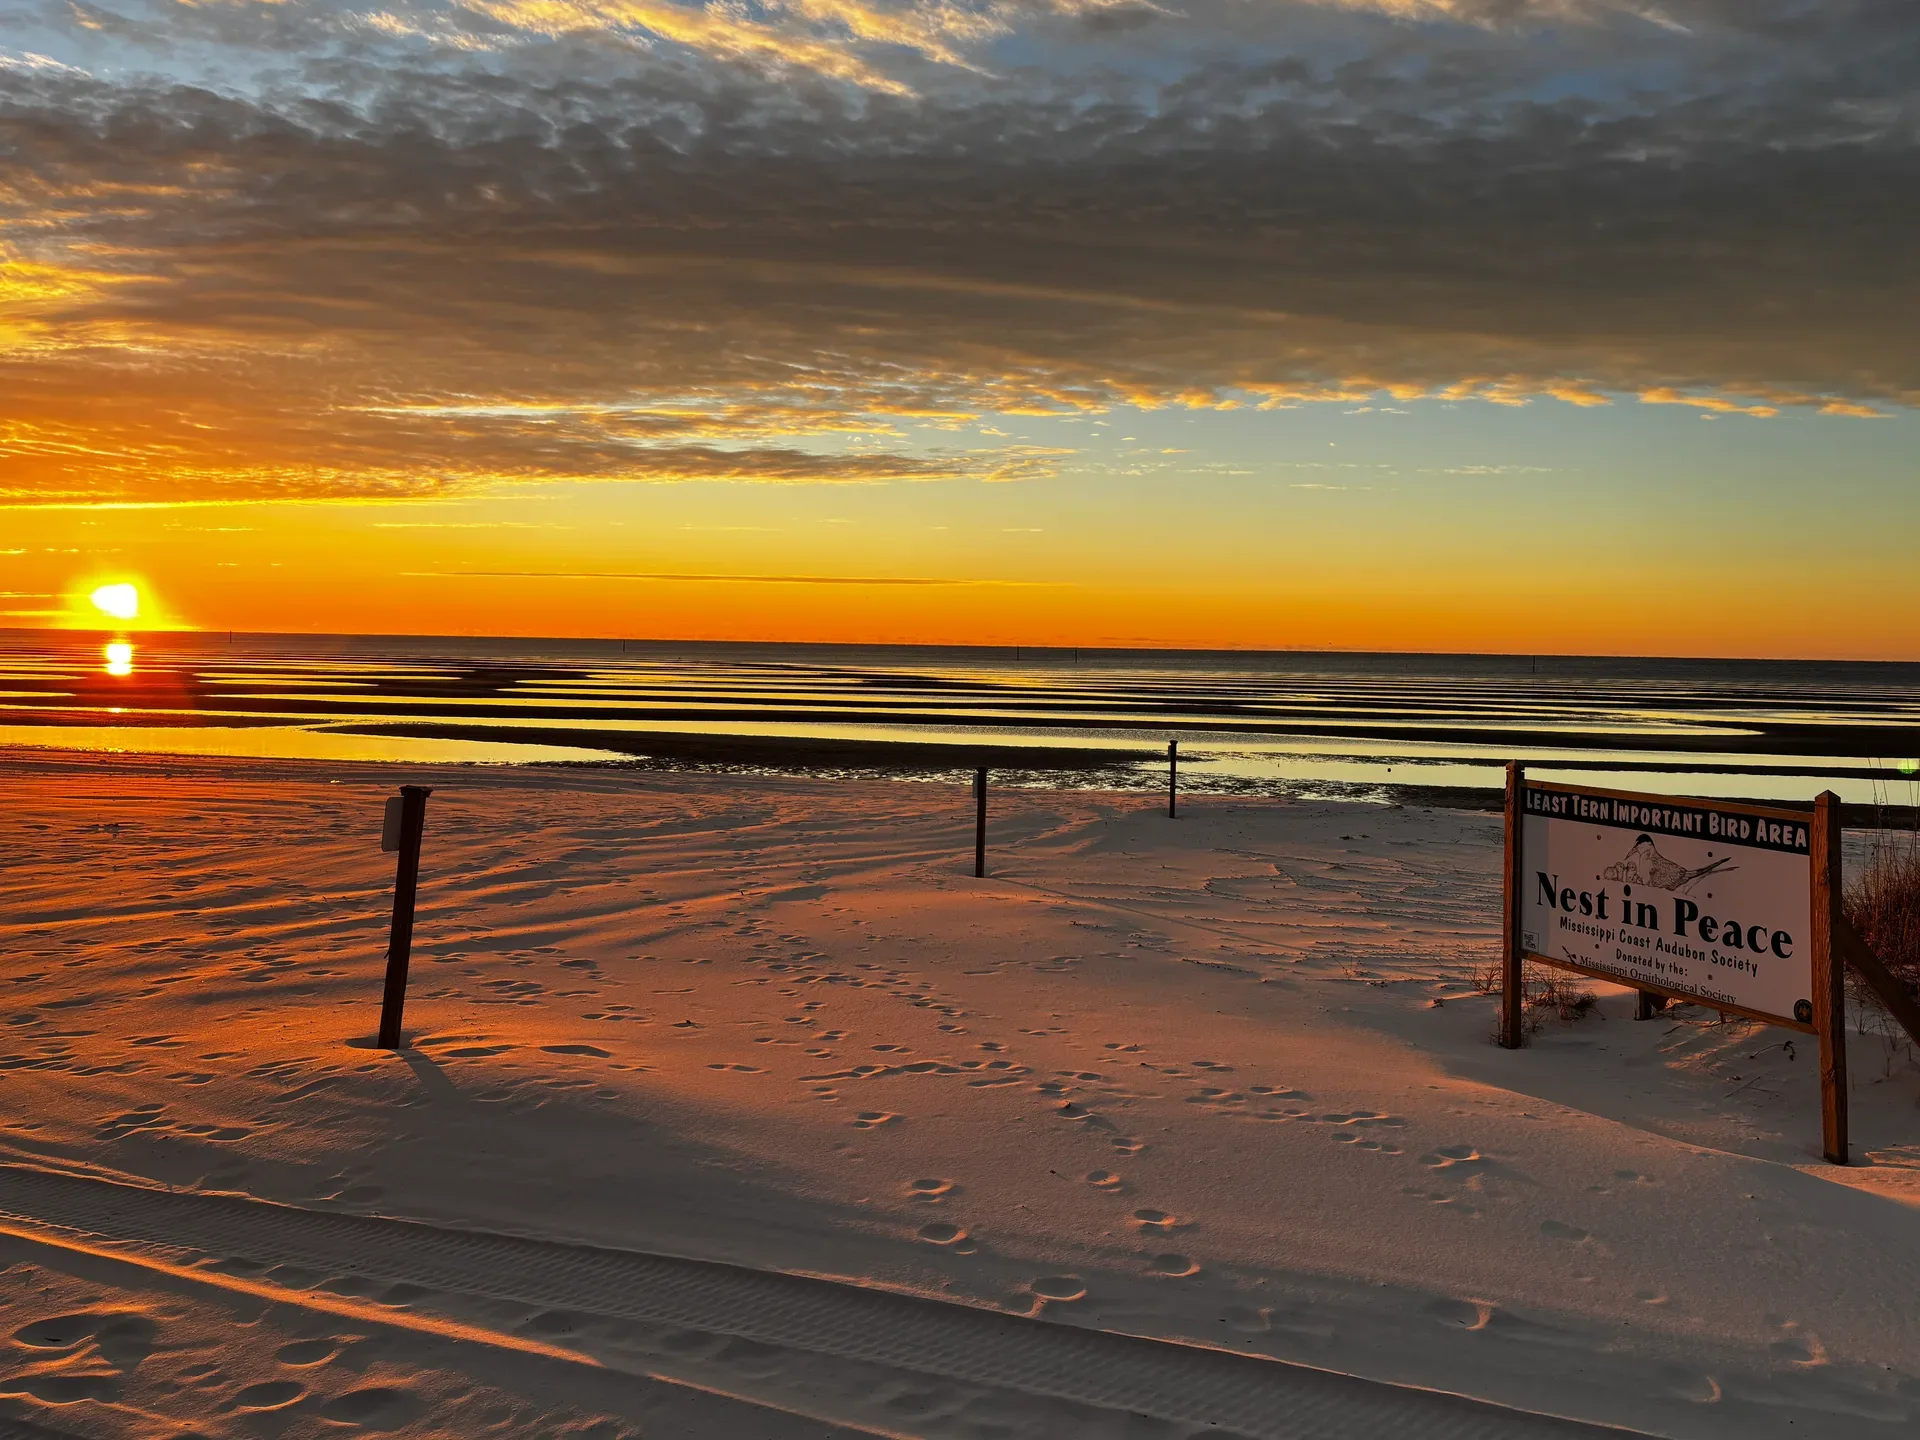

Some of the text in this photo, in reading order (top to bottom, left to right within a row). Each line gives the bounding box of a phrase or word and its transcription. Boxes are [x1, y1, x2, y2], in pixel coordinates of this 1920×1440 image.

[1526, 790, 1807, 848] LEAST TERN IMPORTANT BIRD AREA
[1536, 871, 1794, 959] Nest in Peace
[1560, 916, 1615, 943] Mississippi
[1619, 929, 1651, 949] Coast
[1656, 937, 1706, 962] Audubon
[1711, 949, 1758, 978] Society
[1616, 948, 1689, 977] Donated by the:
[1580, 955, 1737, 1004] Mississippi Ornithological Society
